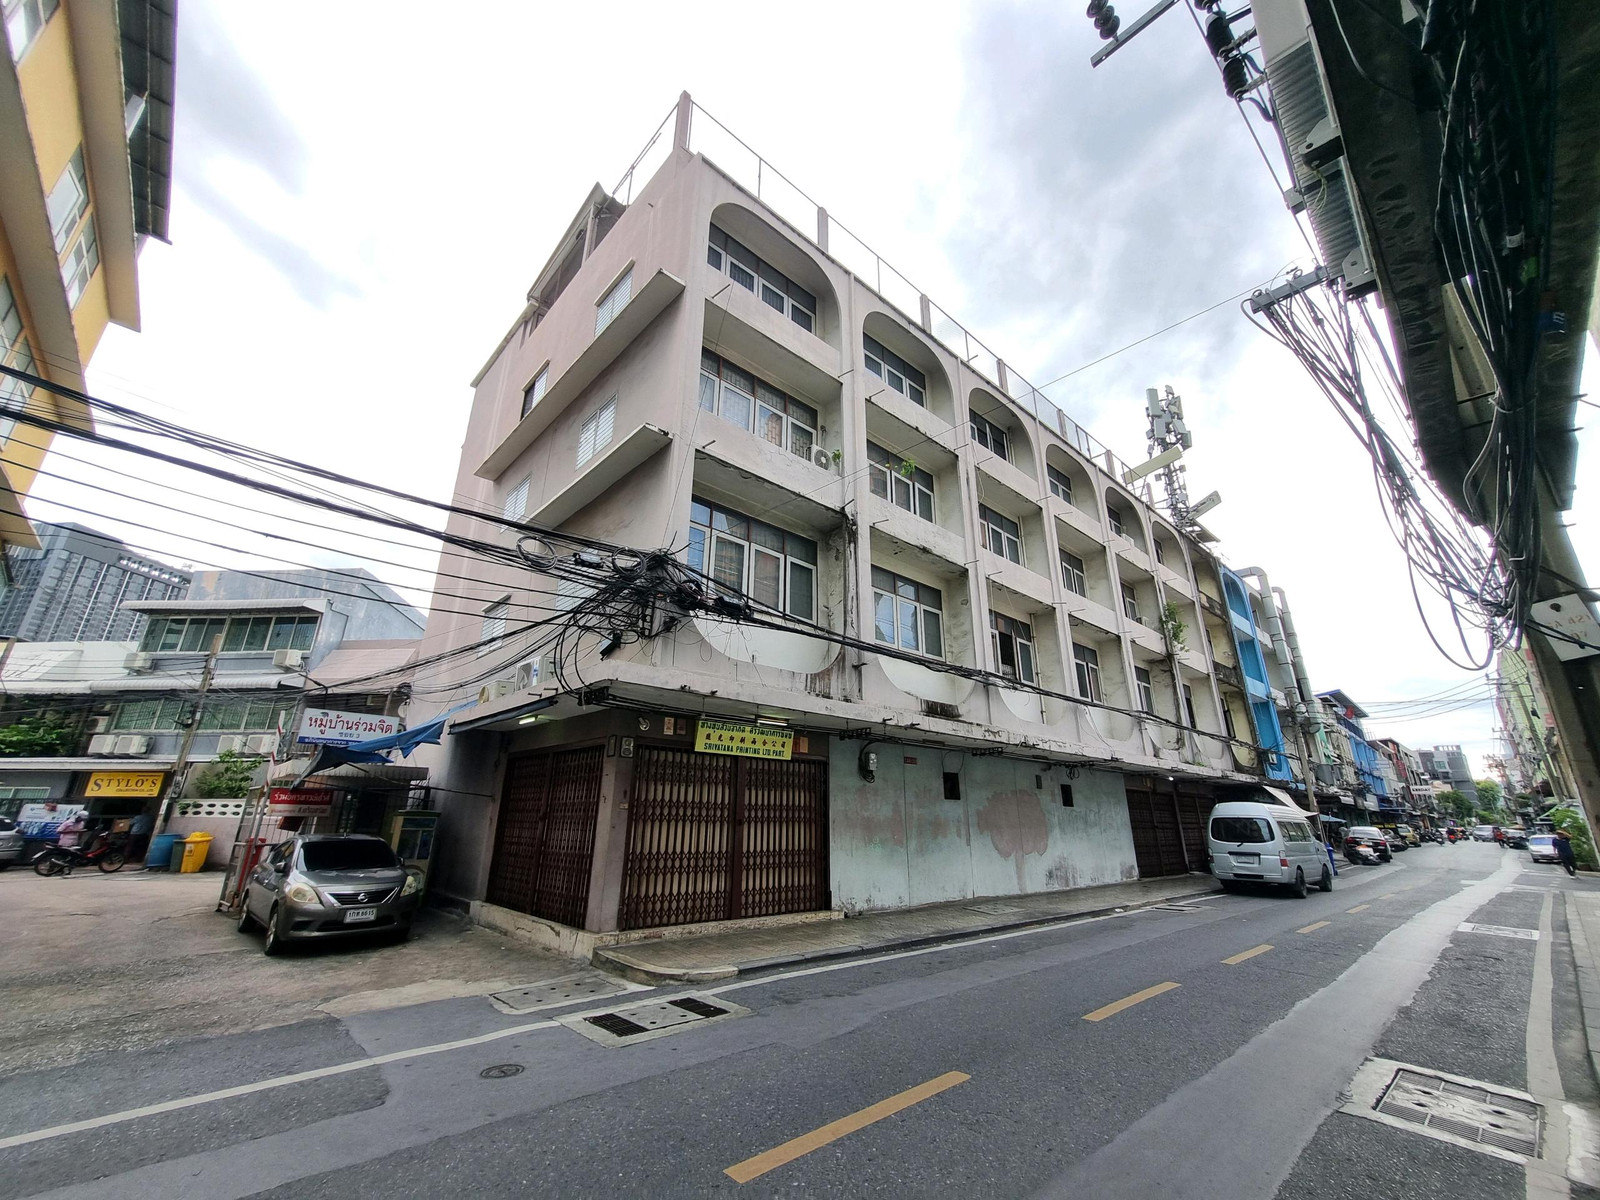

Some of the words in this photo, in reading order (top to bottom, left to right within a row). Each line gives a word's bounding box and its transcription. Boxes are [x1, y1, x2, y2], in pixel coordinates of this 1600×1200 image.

[308, 713, 393, 735] หมู่บ้านร่วมจิต
[735, 745, 761, 755] PRINTING
[91, 777, 158, 792] STYLO'S
